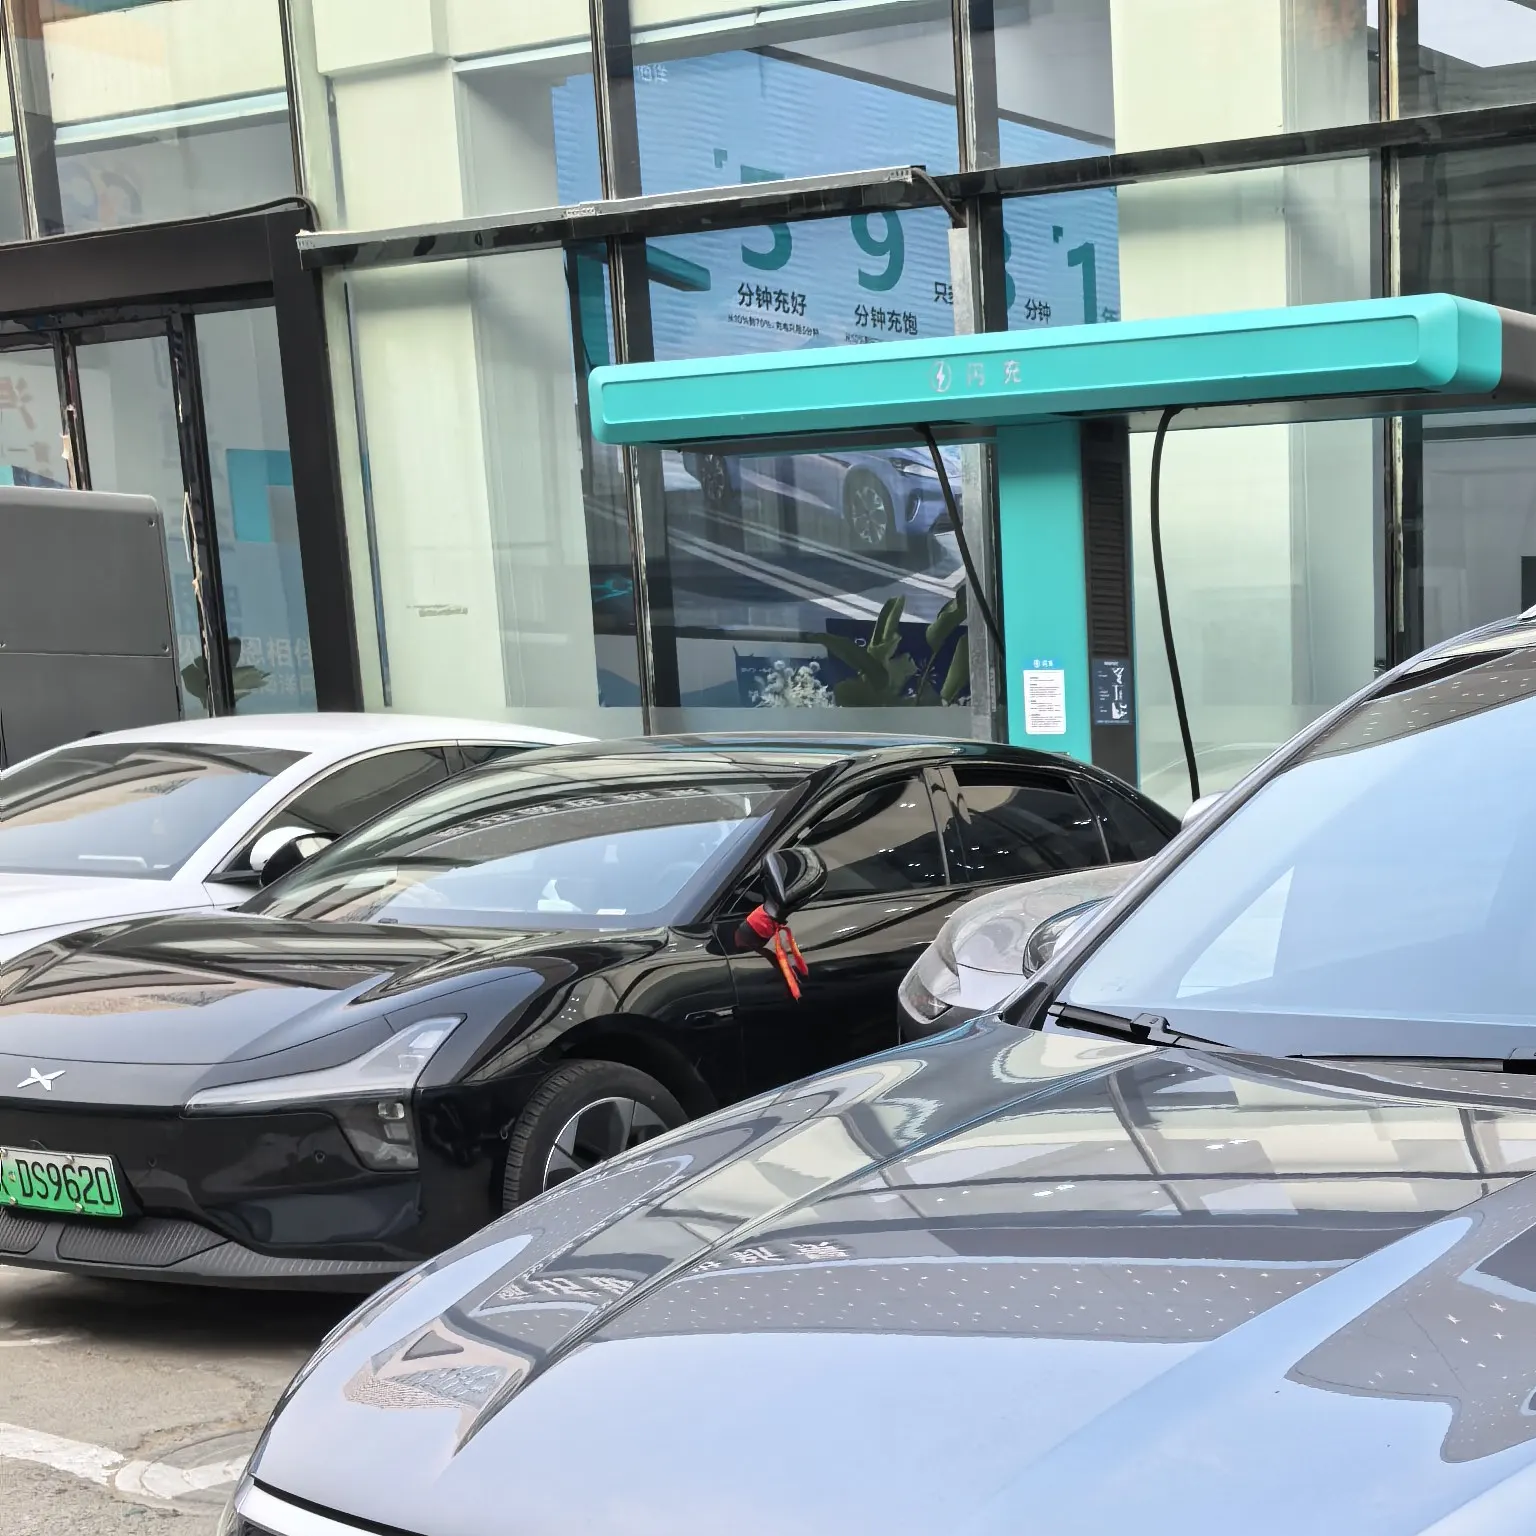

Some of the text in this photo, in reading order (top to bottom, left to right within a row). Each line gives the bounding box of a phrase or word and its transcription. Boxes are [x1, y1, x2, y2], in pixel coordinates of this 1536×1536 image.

[850, 208, 905, 291] 9
[737, 282, 807, 316] 分钟充好
[1025, 298, 1050, 324] 分钟
[854, 304, 918, 335] 分钟充饱
[966, 360, 1022, 388] 闪充
[0, 1157, 115, 1206] DS9620
